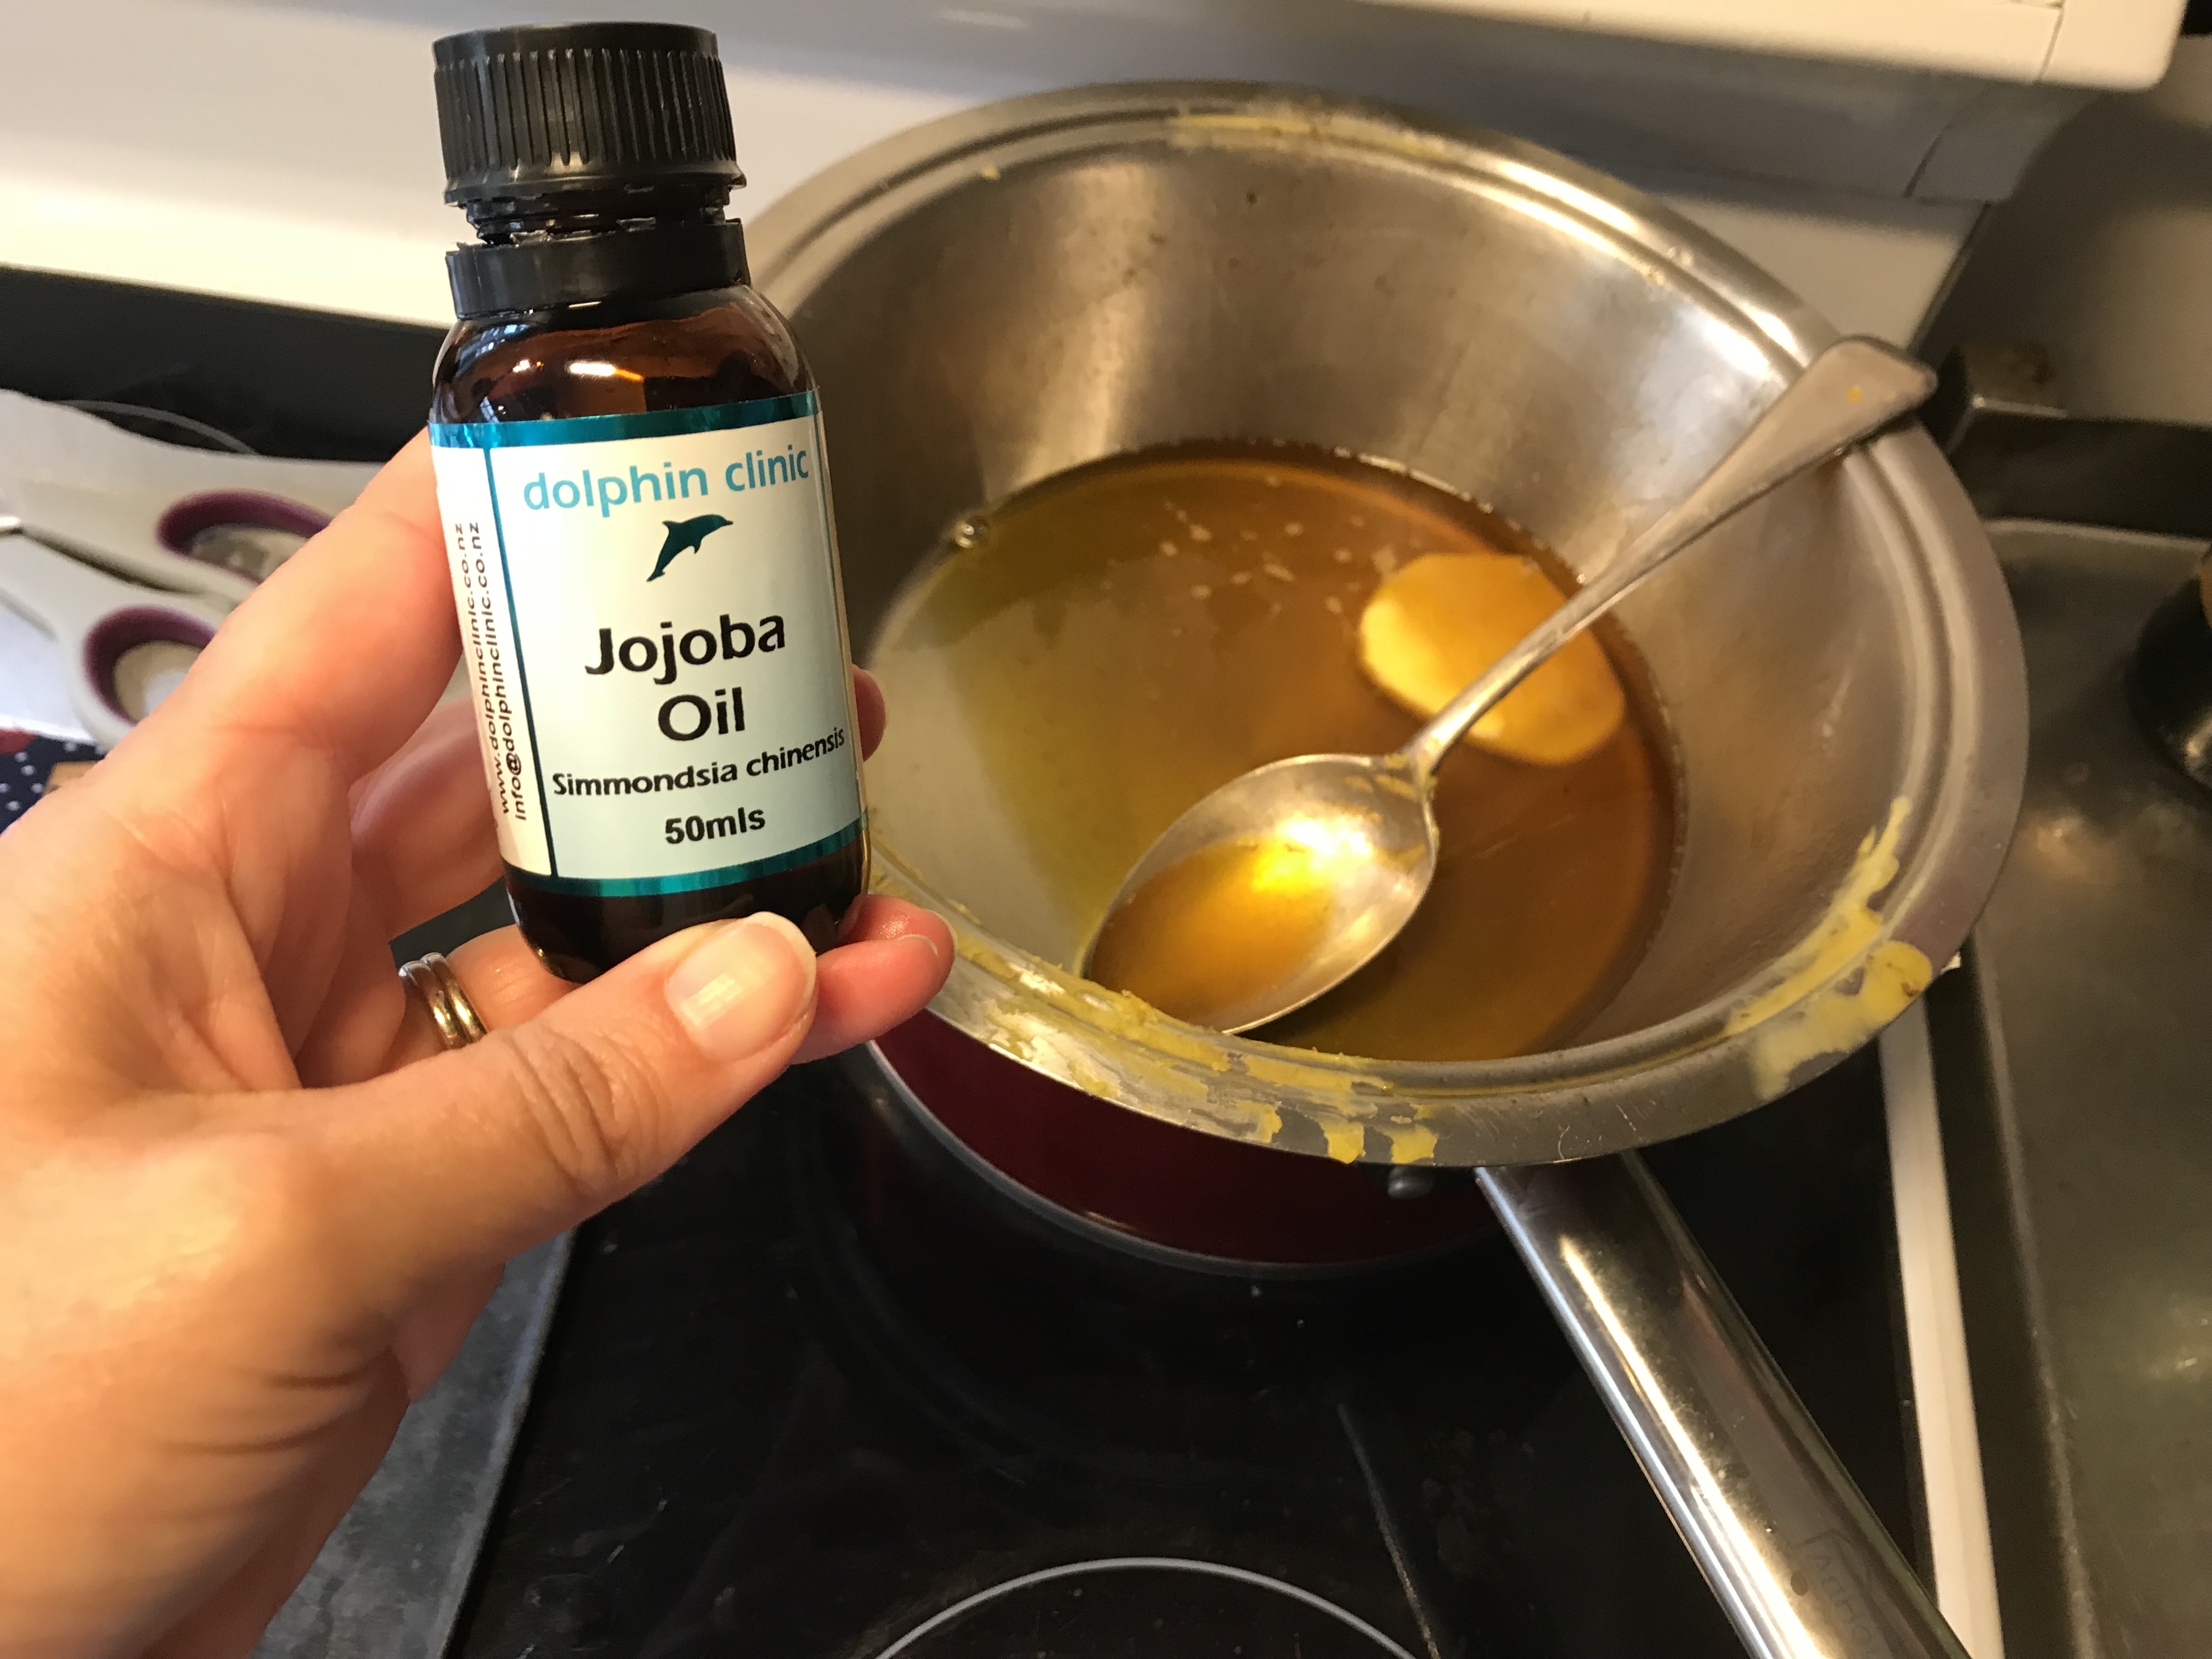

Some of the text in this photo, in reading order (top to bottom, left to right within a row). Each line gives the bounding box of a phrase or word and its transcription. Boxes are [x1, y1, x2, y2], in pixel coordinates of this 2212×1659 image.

[524, 445, 809, 517] dolphin clinic
[455, 523, 509, 815] www.dolphinclinic.co.nz
[469, 522, 526, 820] info@dolphinclinic.co.nz
[585, 614, 786, 685] Jojoba
[658, 687, 746, 741] Oil
[552, 726, 845, 795] Simmondsia chinensis
[665, 807, 766, 844] 50mls
